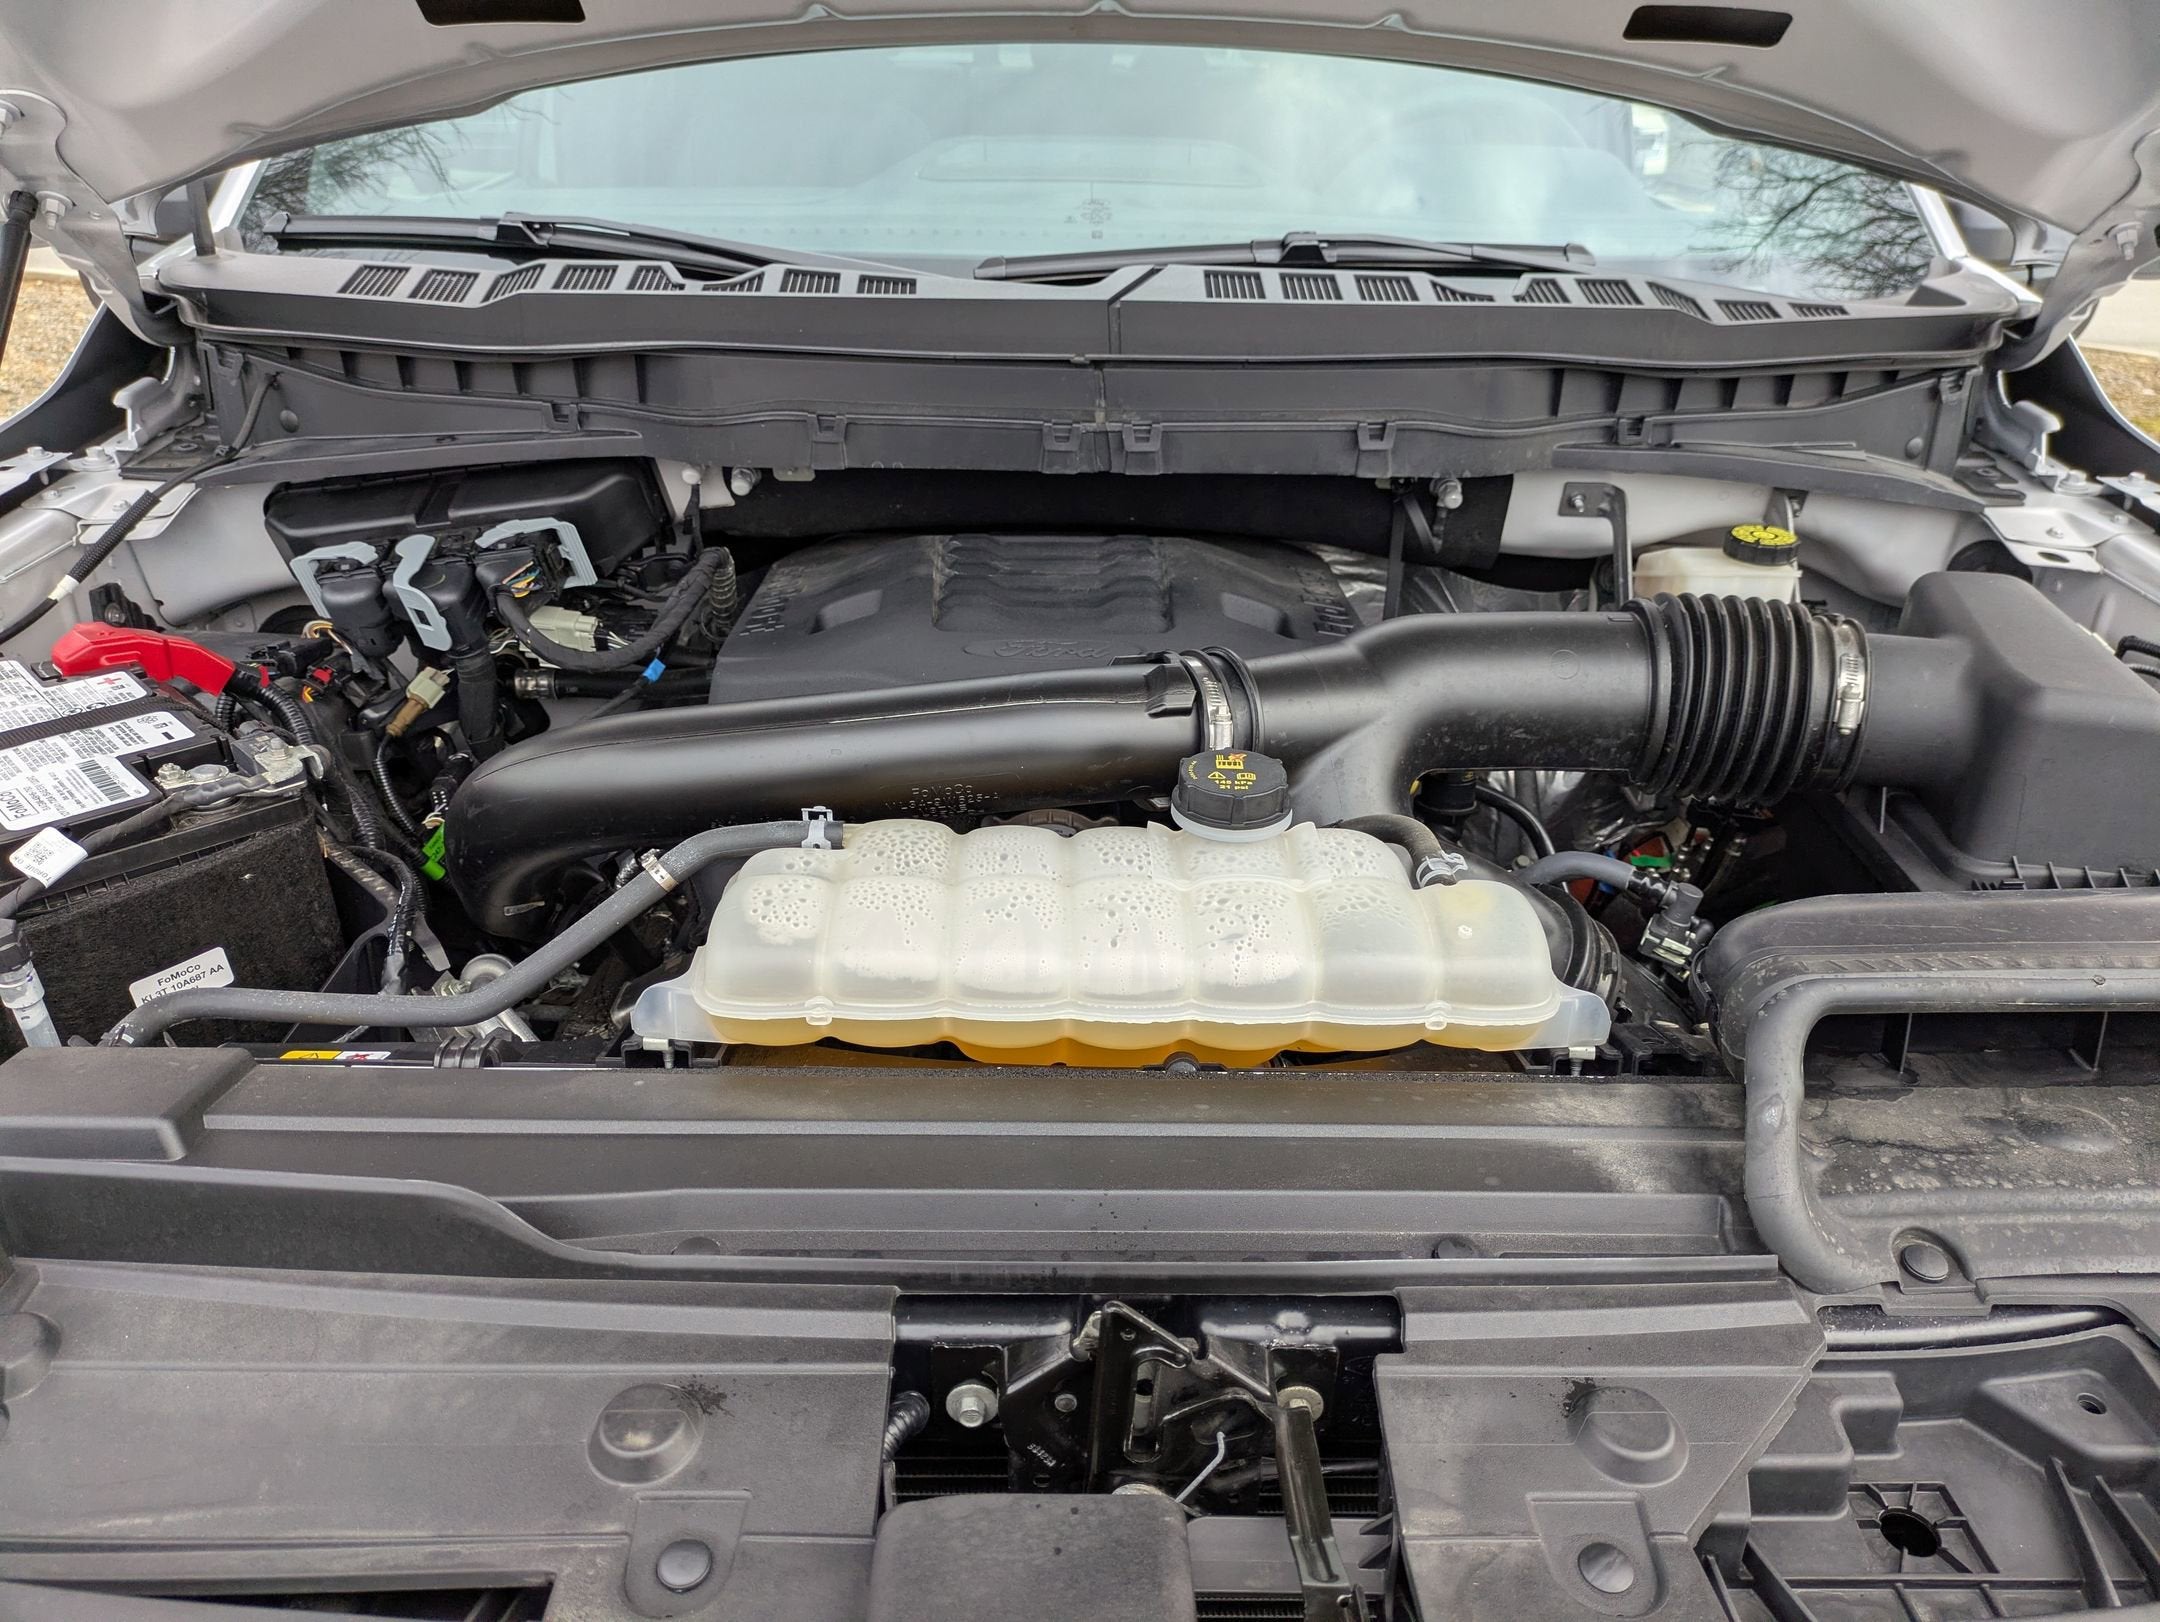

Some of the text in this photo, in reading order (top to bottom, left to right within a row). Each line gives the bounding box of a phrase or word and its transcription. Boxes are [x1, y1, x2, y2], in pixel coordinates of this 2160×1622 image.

[0, 791, 32, 818] FoMoCo
[157, 964, 201, 987] FoMoCo
[171, 971, 206, 992] 10A687
[209, 964, 225, 975] AA
